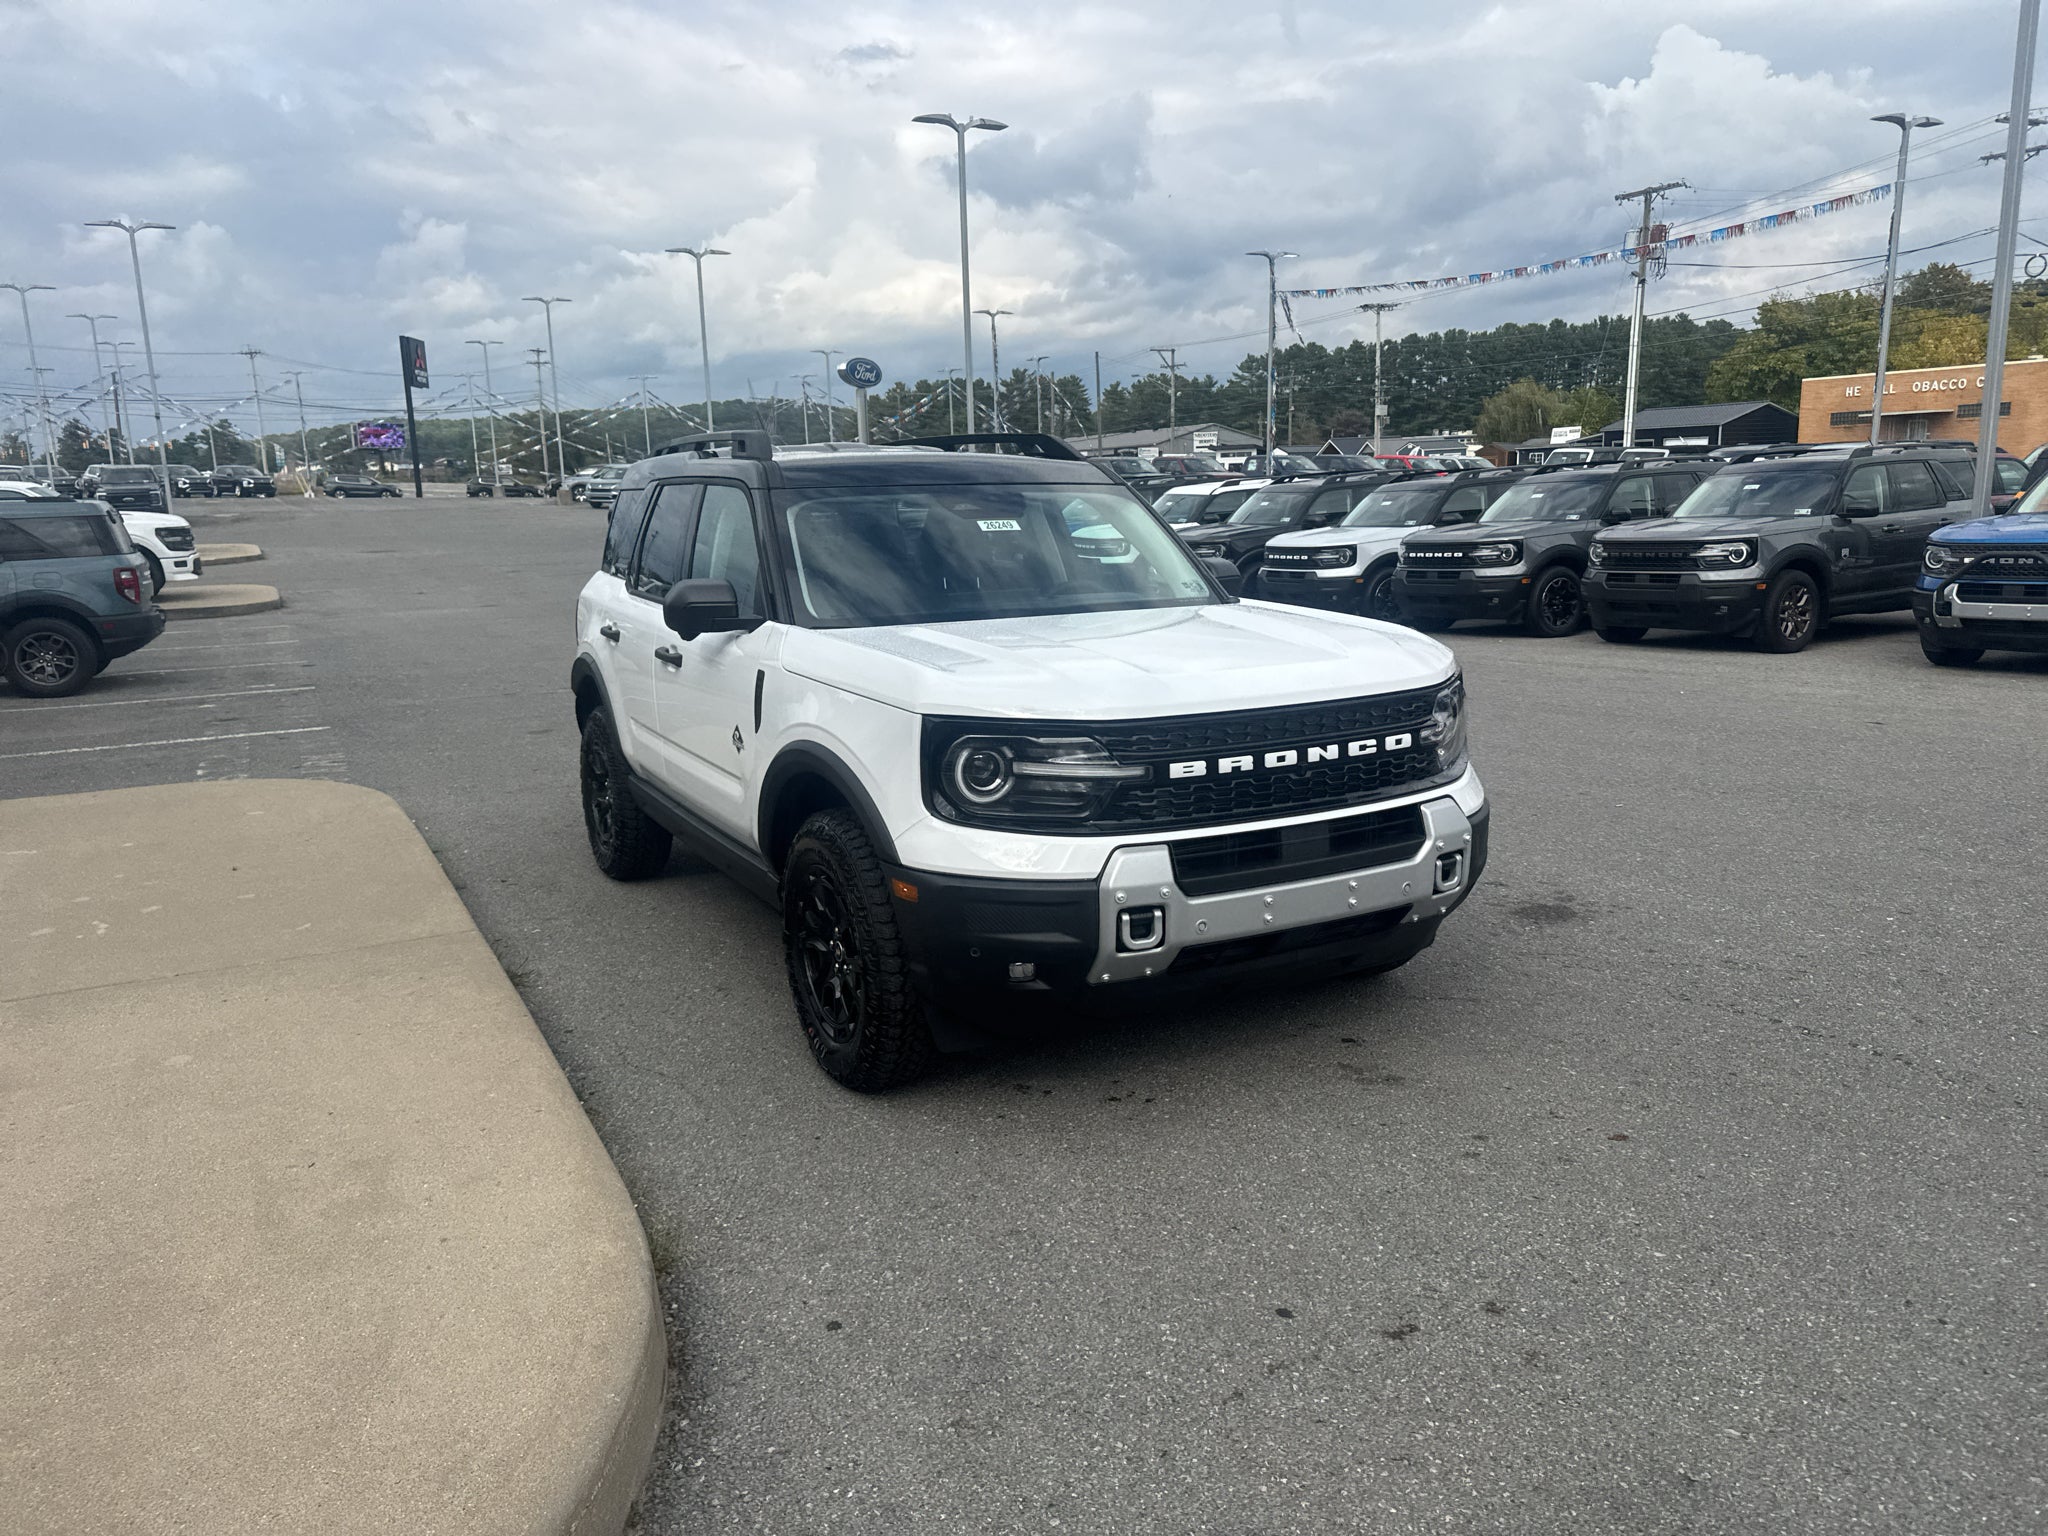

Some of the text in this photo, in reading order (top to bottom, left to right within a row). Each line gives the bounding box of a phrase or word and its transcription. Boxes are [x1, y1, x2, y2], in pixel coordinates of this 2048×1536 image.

[855, 362, 876, 381] Ford
[1912, 378, 1967, 392] OBACCO
[983, 521, 1014, 530] 26249
[1169, 733, 1412, 779] BRONCO
